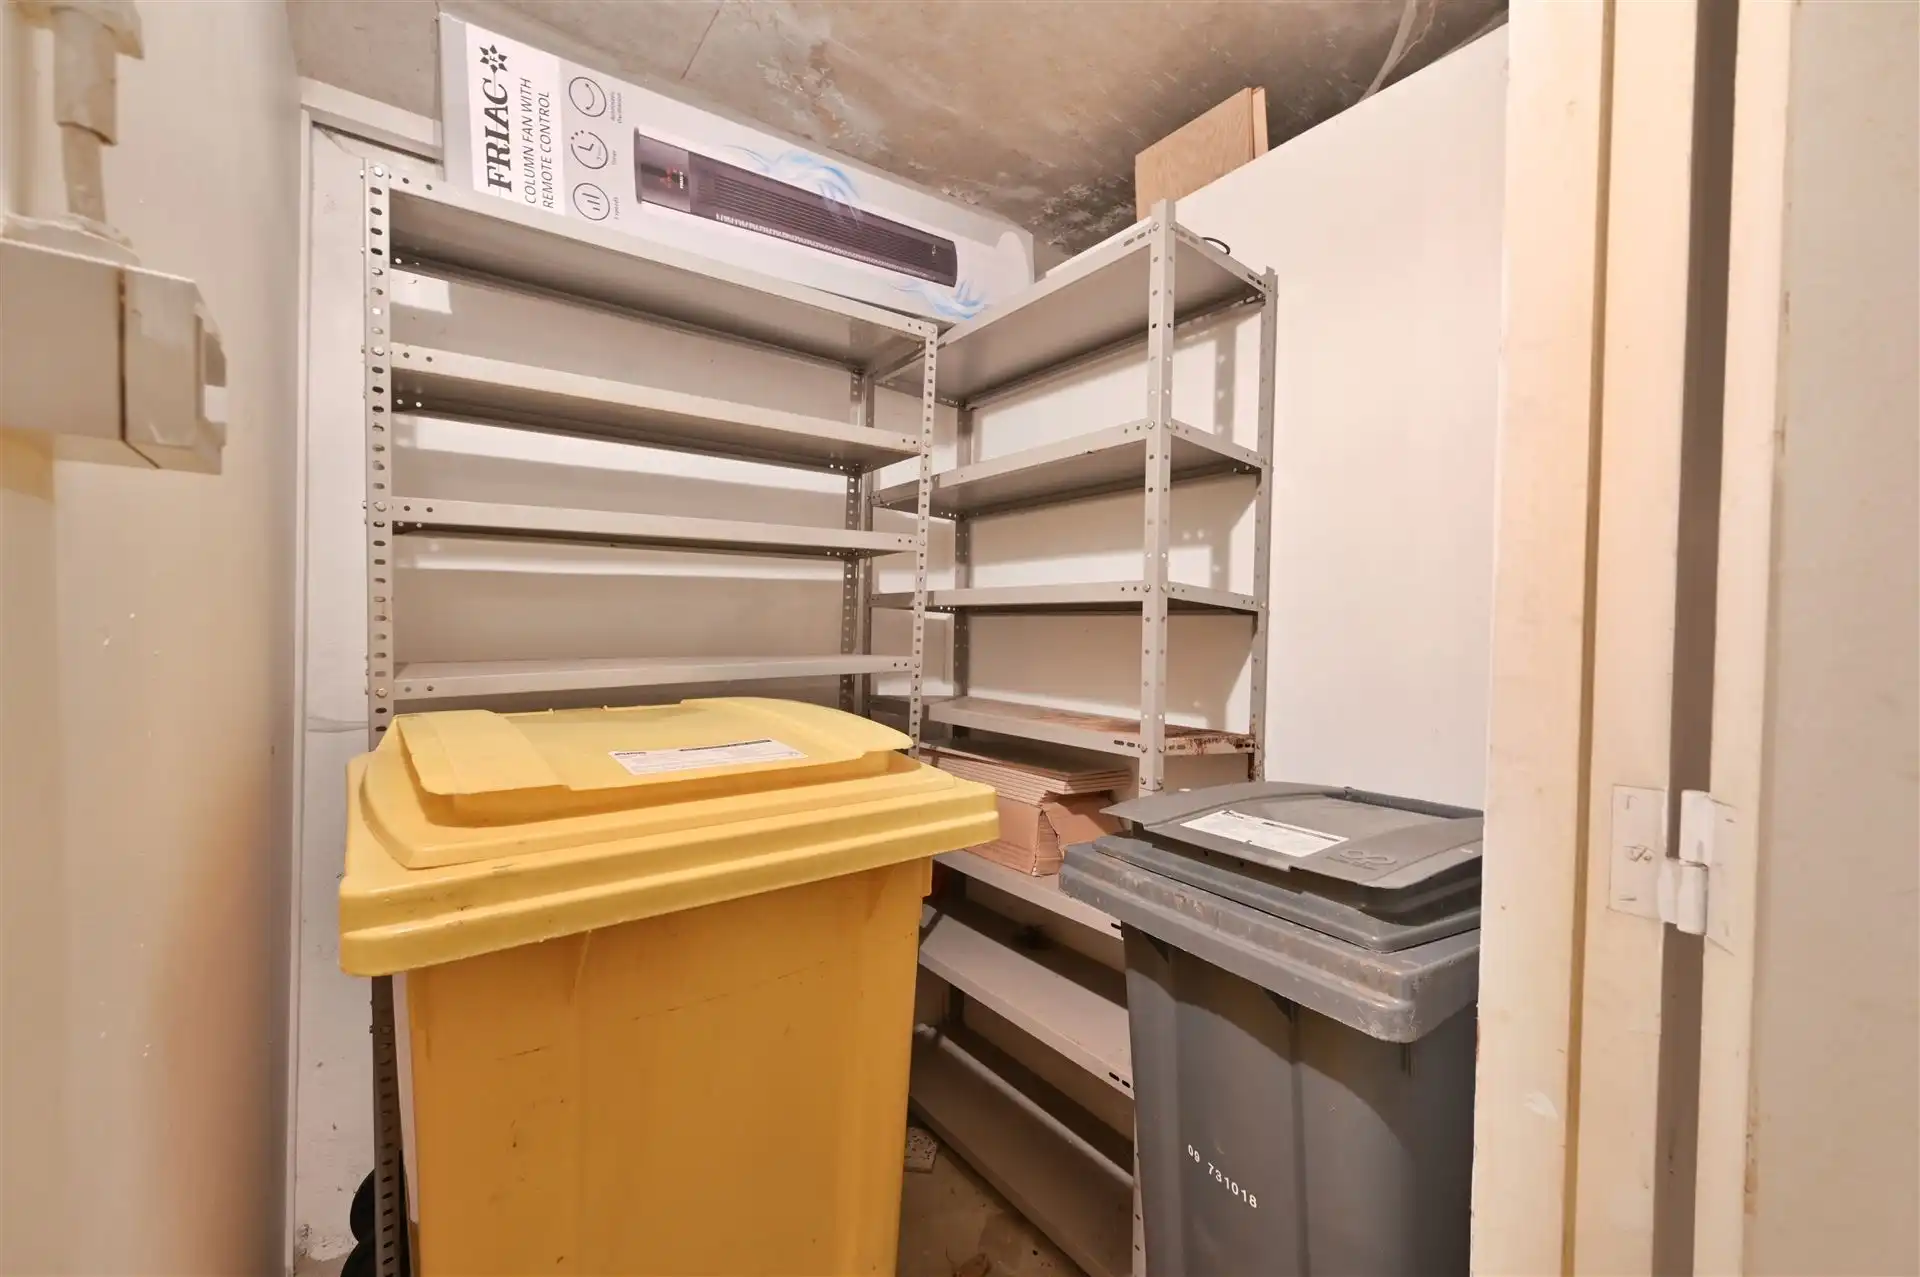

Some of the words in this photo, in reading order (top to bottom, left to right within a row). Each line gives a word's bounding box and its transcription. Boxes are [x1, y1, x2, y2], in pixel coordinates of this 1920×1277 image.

[519, 77, 533, 112] WITH
[482, 77, 512, 193] FRIAC
[521, 115, 535, 143] FAN
[538, 91, 551, 153] CONTROL
[523, 146, 537, 204] COLUMN
[539, 156, 554, 209] REMOTE
[1207, 1161, 1257, 1209] 731018
